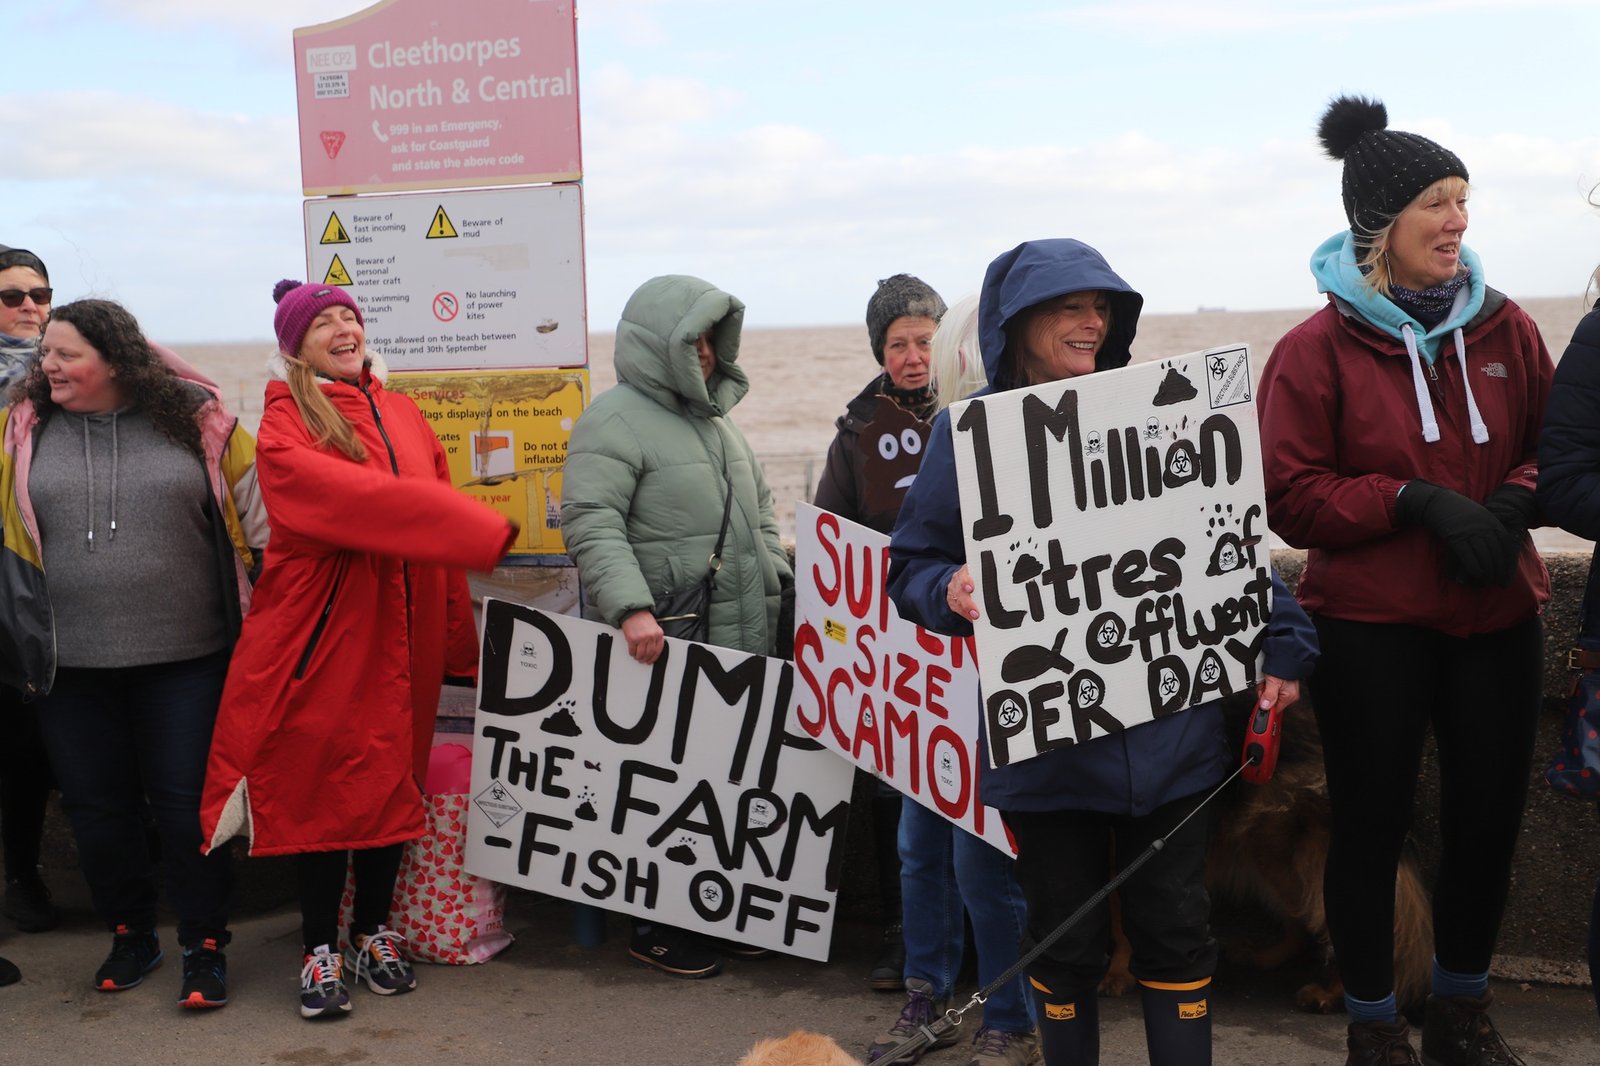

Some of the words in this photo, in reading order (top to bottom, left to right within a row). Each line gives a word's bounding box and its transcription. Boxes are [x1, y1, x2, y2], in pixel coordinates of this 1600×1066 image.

[368, 37, 521, 68] Cleethorpes
[369, 79, 443, 110] North
[451, 78, 470, 104] &
[478, 67, 572, 101] Central
[389, 124, 409, 136] 999
[412, 123, 422, 134] in
[425, 124, 438, 133] an
[441, 119, 502, 133] Emergency,
[391, 142, 408, 154] ask
[411, 141, 426, 153] for
[429, 137, 490, 152] Coastguard
[392, 160, 411, 172] and
[414, 159, 440, 171] state
[443, 158, 461, 169] the
[463, 155, 496, 168] above
[498, 153, 524, 165] code
[384, 213, 393, 221] of
[462, 219, 492, 228] Beware
[495, 217, 504, 226] of
[354, 225, 369, 233] fast
[372, 224, 406, 233] incoming
[463, 229, 480, 238] mud
[355, 235, 373, 244] tides
[355, 257, 384, 265] Beware
[387, 256, 395, 264] of
[356, 266, 389, 277] personal
[382, 276, 401, 285] craft
[357, 295, 368, 303] No
[371, 295, 410, 303] swimming
[466, 291, 477, 299] No
[480, 289, 516, 299] launching
[367, 305, 392, 313] launch
[466, 301, 475, 309] of
[478, 302, 503, 310] power
[466, 312, 485, 320] kites
[373, 336, 392, 345] dogs
[394, 335, 424, 344] allowed
[440, 334, 453, 342] the
[456, 333, 479, 341] beach
[481, 332, 516, 341] between
[384, 346, 406, 355] Friday
[409, 345, 424, 353] and
[427, 345, 443, 353] 30th
[446, 344, 487, 354] September
[1228, 354, 1246, 381] SUBSTANCE
[413, 388, 465, 400] Services
[446, 408, 492, 420] displayed
[513, 407, 529, 417] the
[533, 406, 562, 417] beach
[448, 446, 458, 454] or
[523, 442, 537, 451] Do
[541, 442, 557, 451] not
[956, 399, 1013, 541] 1
[1022, 389, 1242, 529] Million
[490, 494, 511, 504] year
[981, 537, 1186, 629] Litres
[1086, 566, 1272, 664] effluent
[520, 661, 537, 670] TOXIC
[853, 624, 952, 719] SIZE
[987, 668, 1125, 767] PER
[1147, 627, 1268, 719] DAY
[482, 726, 575, 799] THE
[611, 760, 850, 892] FARM
[689, 870, 830, 947] OFF
